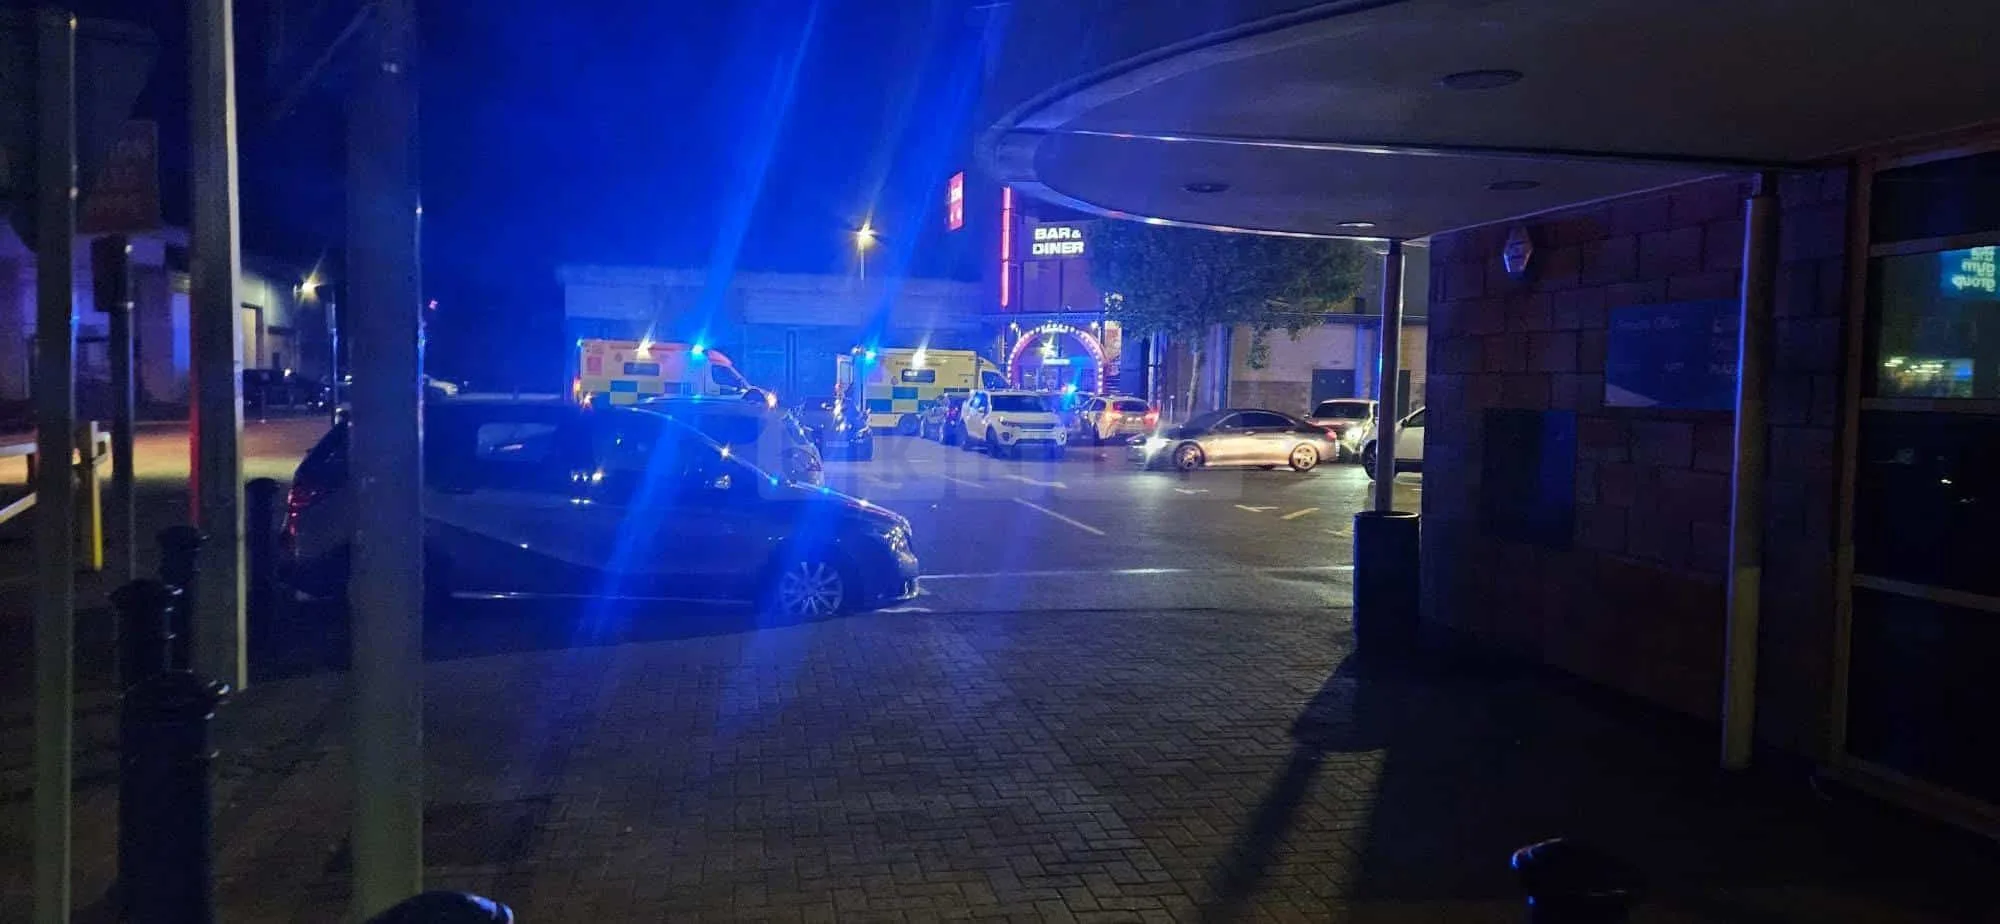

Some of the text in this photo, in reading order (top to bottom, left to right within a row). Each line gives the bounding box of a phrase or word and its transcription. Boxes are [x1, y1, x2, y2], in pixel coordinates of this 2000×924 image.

[1035, 227, 1081, 240] BAR &
[1032, 242, 1084, 255] DINER
